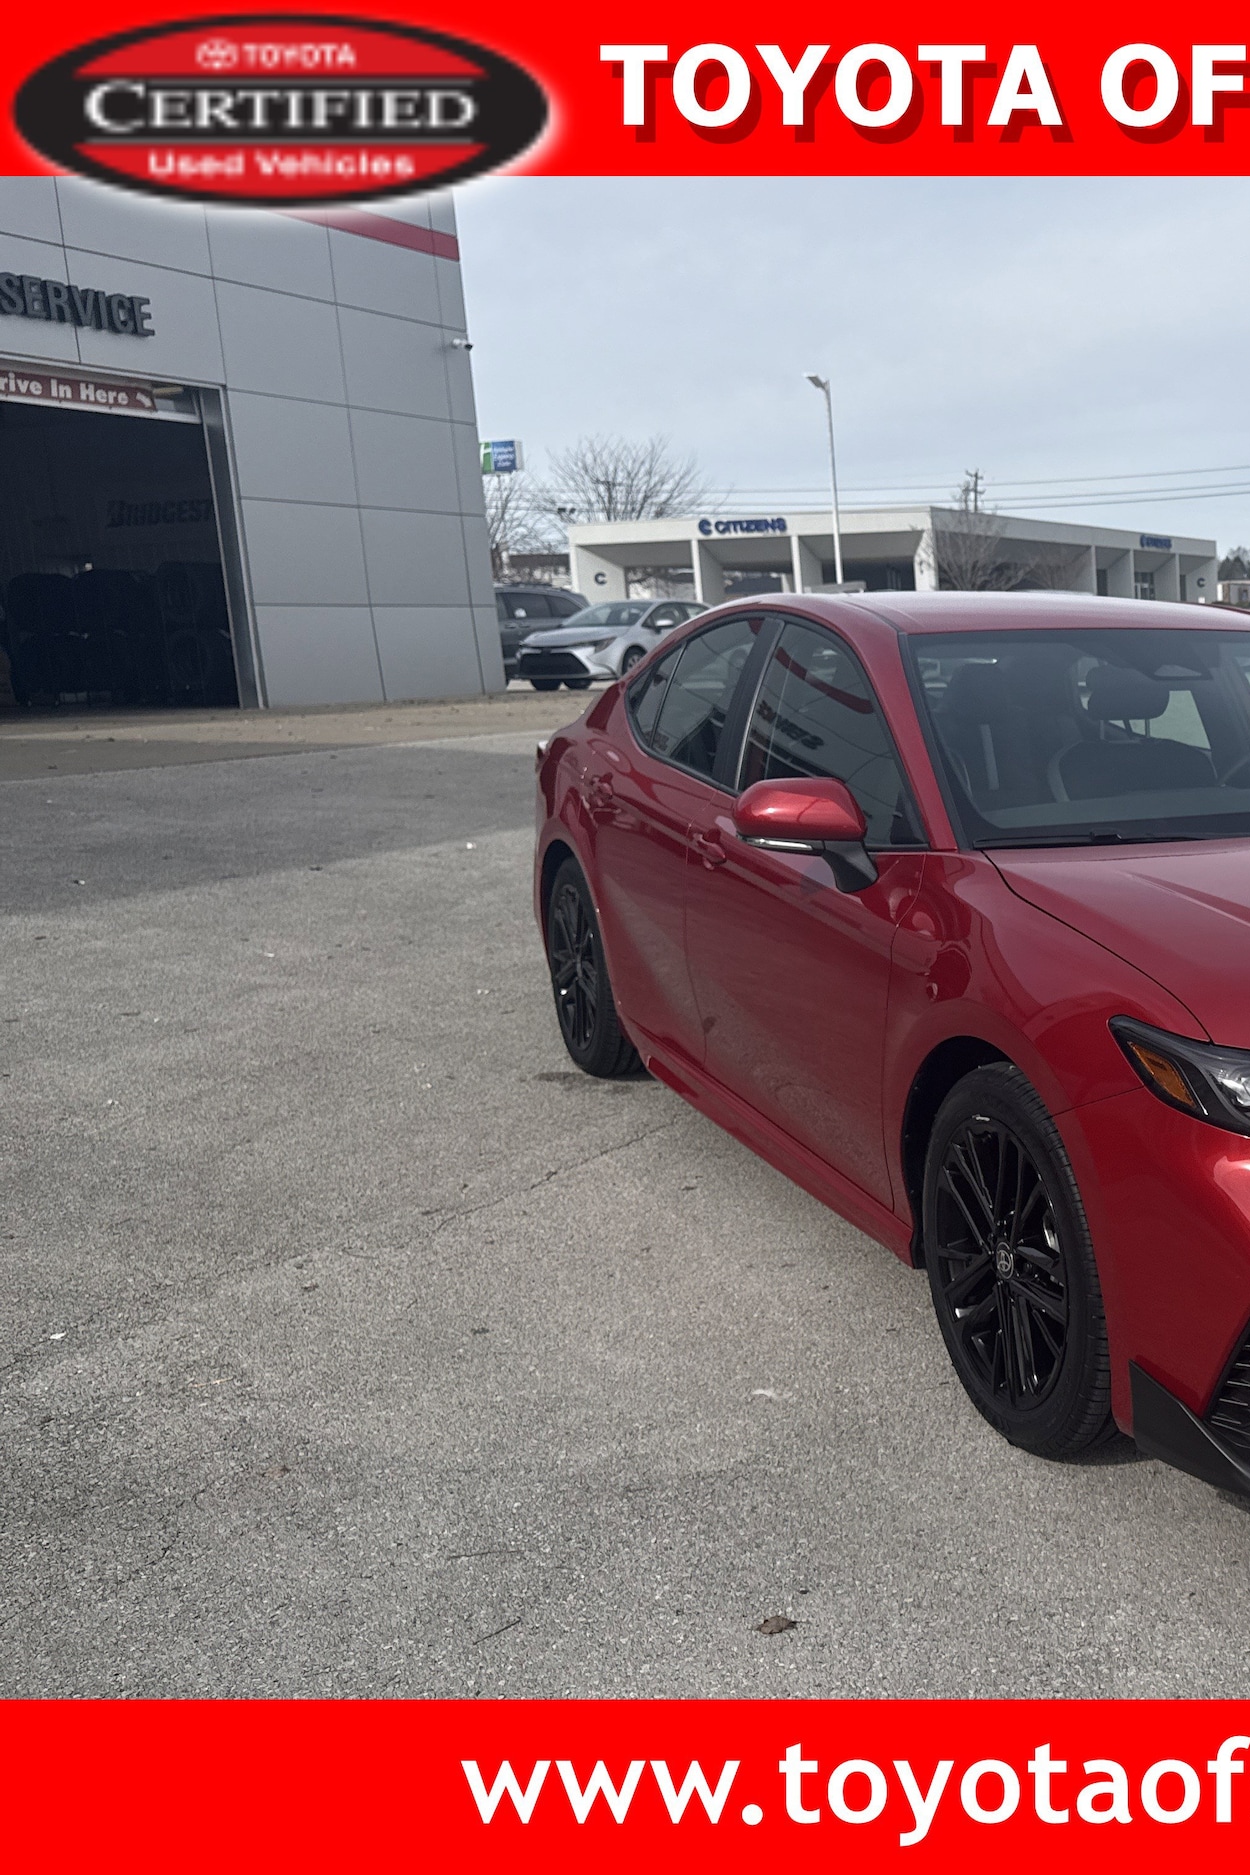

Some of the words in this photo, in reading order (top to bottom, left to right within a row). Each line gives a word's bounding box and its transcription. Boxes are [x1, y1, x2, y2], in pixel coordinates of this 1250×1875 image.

[0, 272, 155, 337] SERVICE
[50, 379, 73, 400] In
[80, 382, 129, 405] Here
